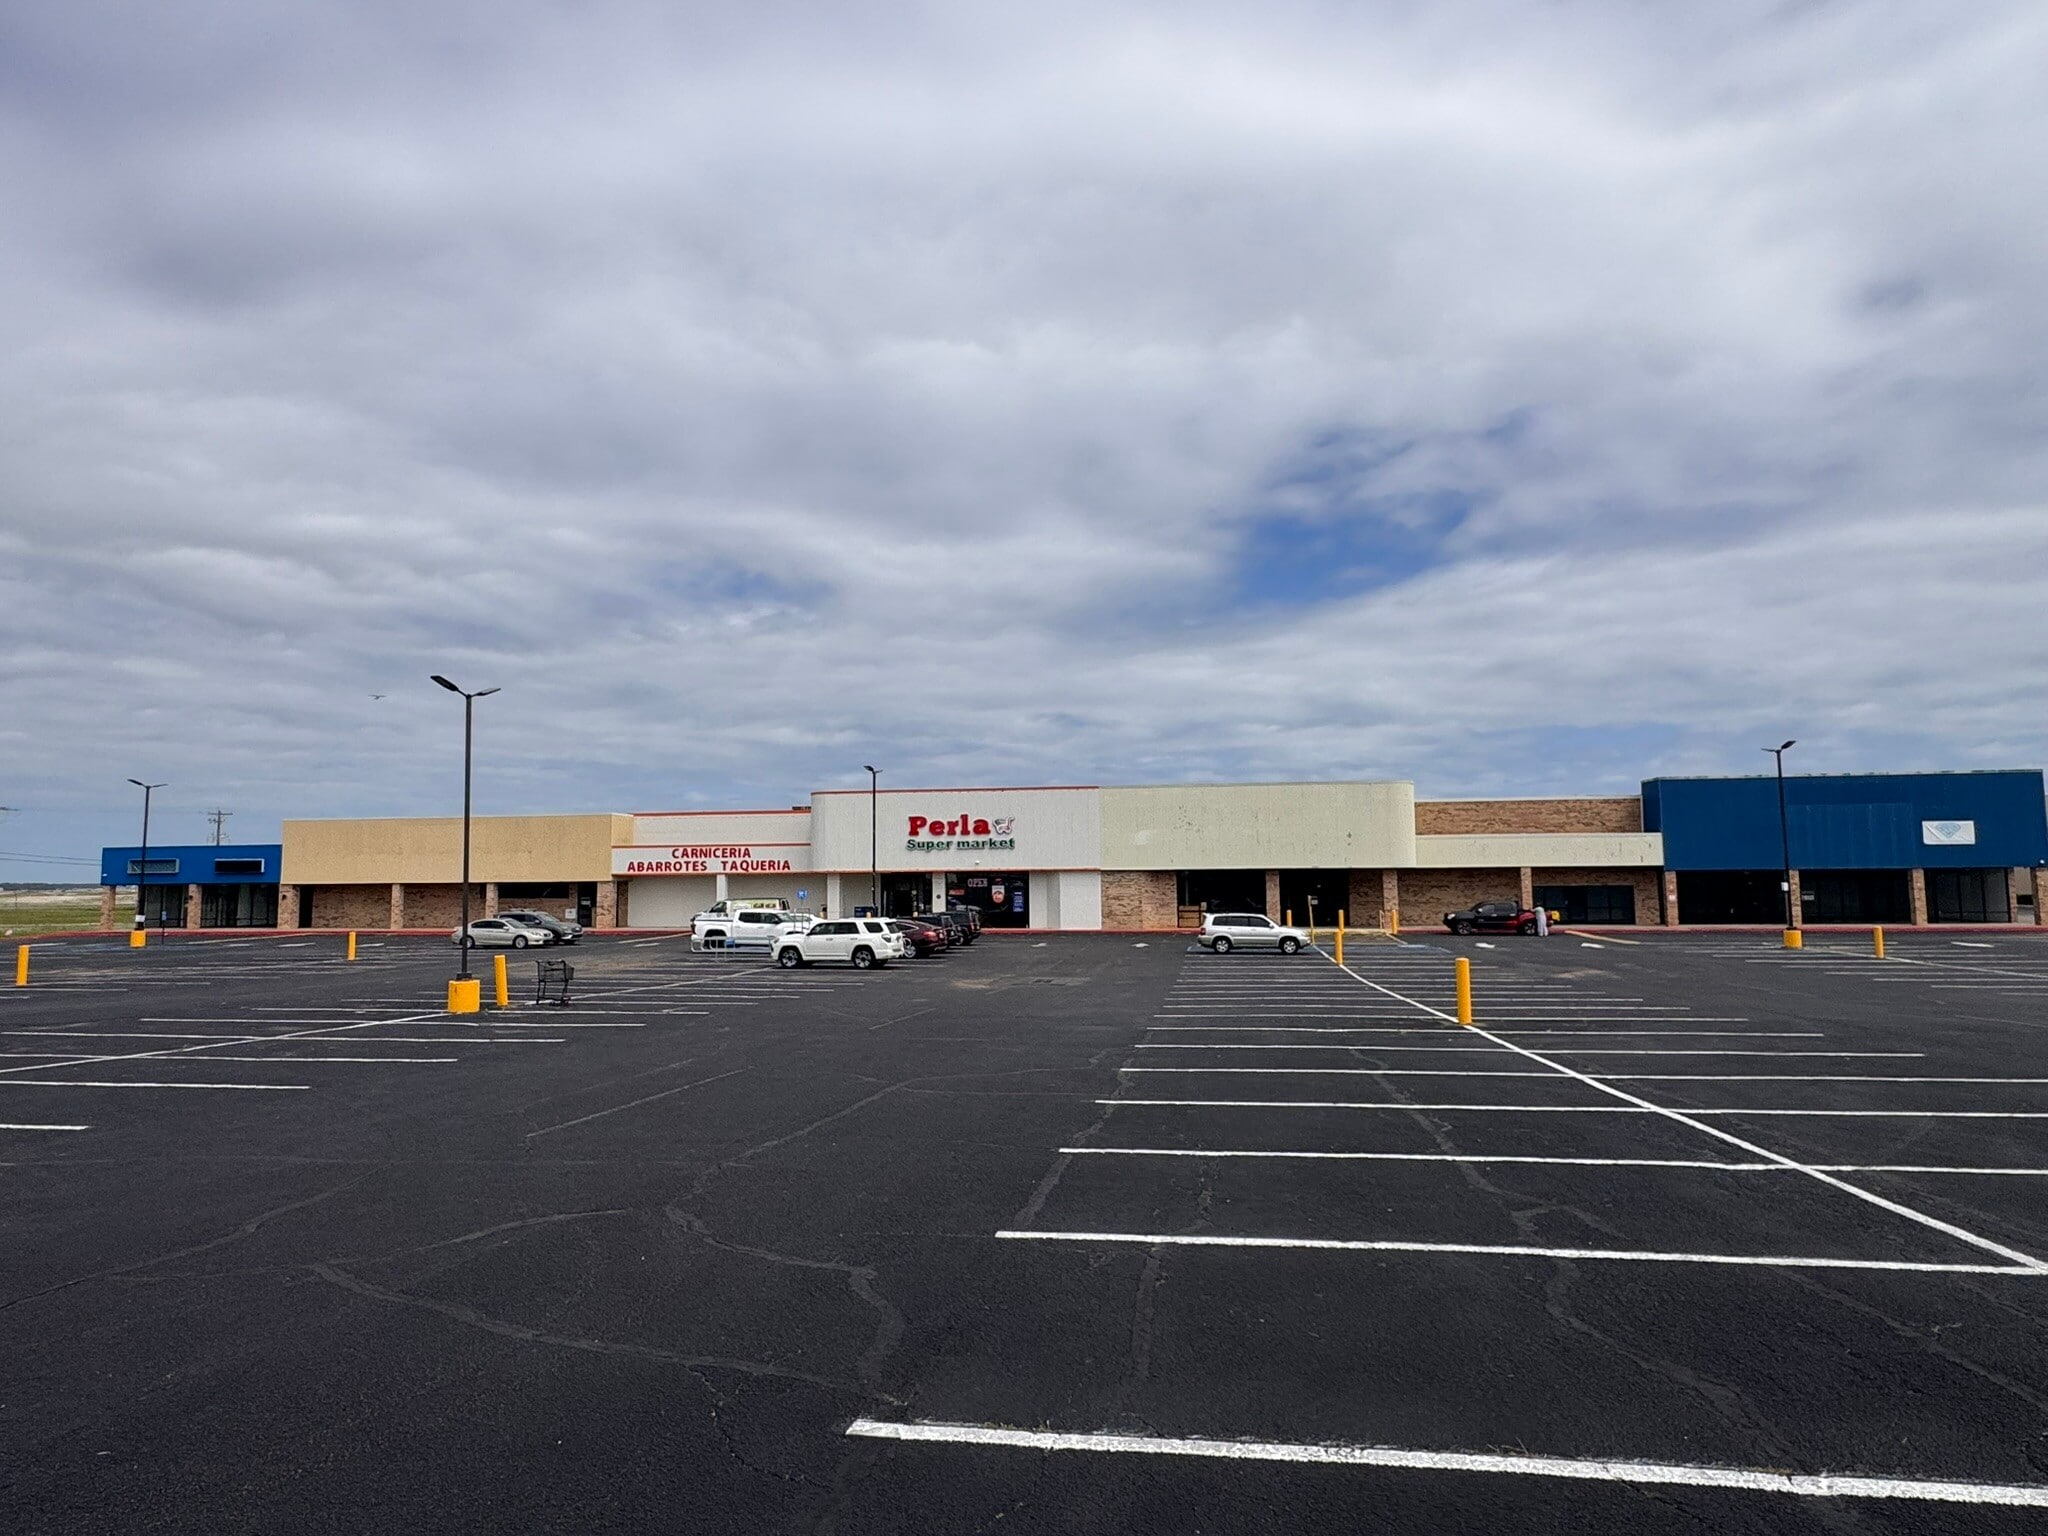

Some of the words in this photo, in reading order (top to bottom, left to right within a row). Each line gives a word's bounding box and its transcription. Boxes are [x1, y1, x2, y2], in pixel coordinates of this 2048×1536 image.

[908, 814, 991, 836] Perla
[906, 838, 953, 852] Super
[957, 837, 1015, 850] market
[672, 847, 751, 859] CARNICERIA
[627, 861, 707, 872] ABARROTES
[721, 860, 791, 872] TAQUERIA
